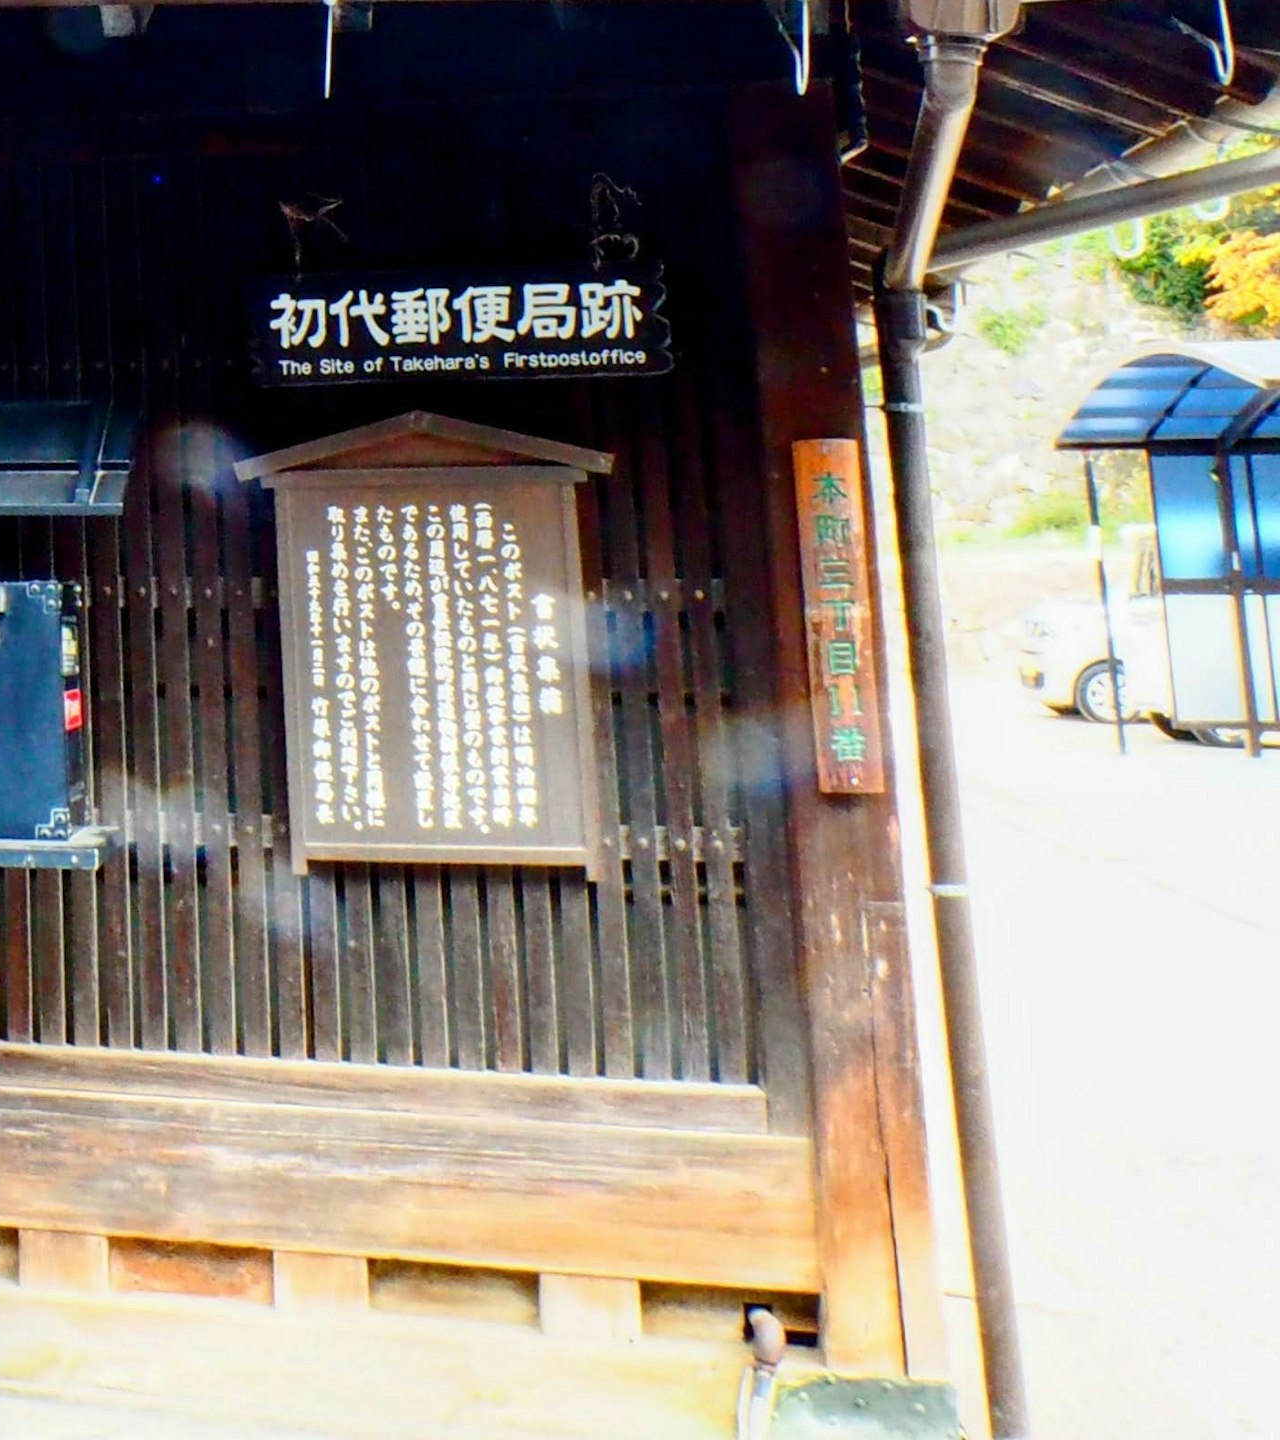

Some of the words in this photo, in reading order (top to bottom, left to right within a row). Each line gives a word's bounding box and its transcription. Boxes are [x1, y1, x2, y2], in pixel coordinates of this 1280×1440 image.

[269, 279, 645, 350] 初代郵便局跡
[278, 359, 312, 375] The
[319, 358, 355, 374] Site
[363, 356, 384, 373] of
[389, 354, 491, 372] Takehara's
[377, 505, 400, 610] たものです。
